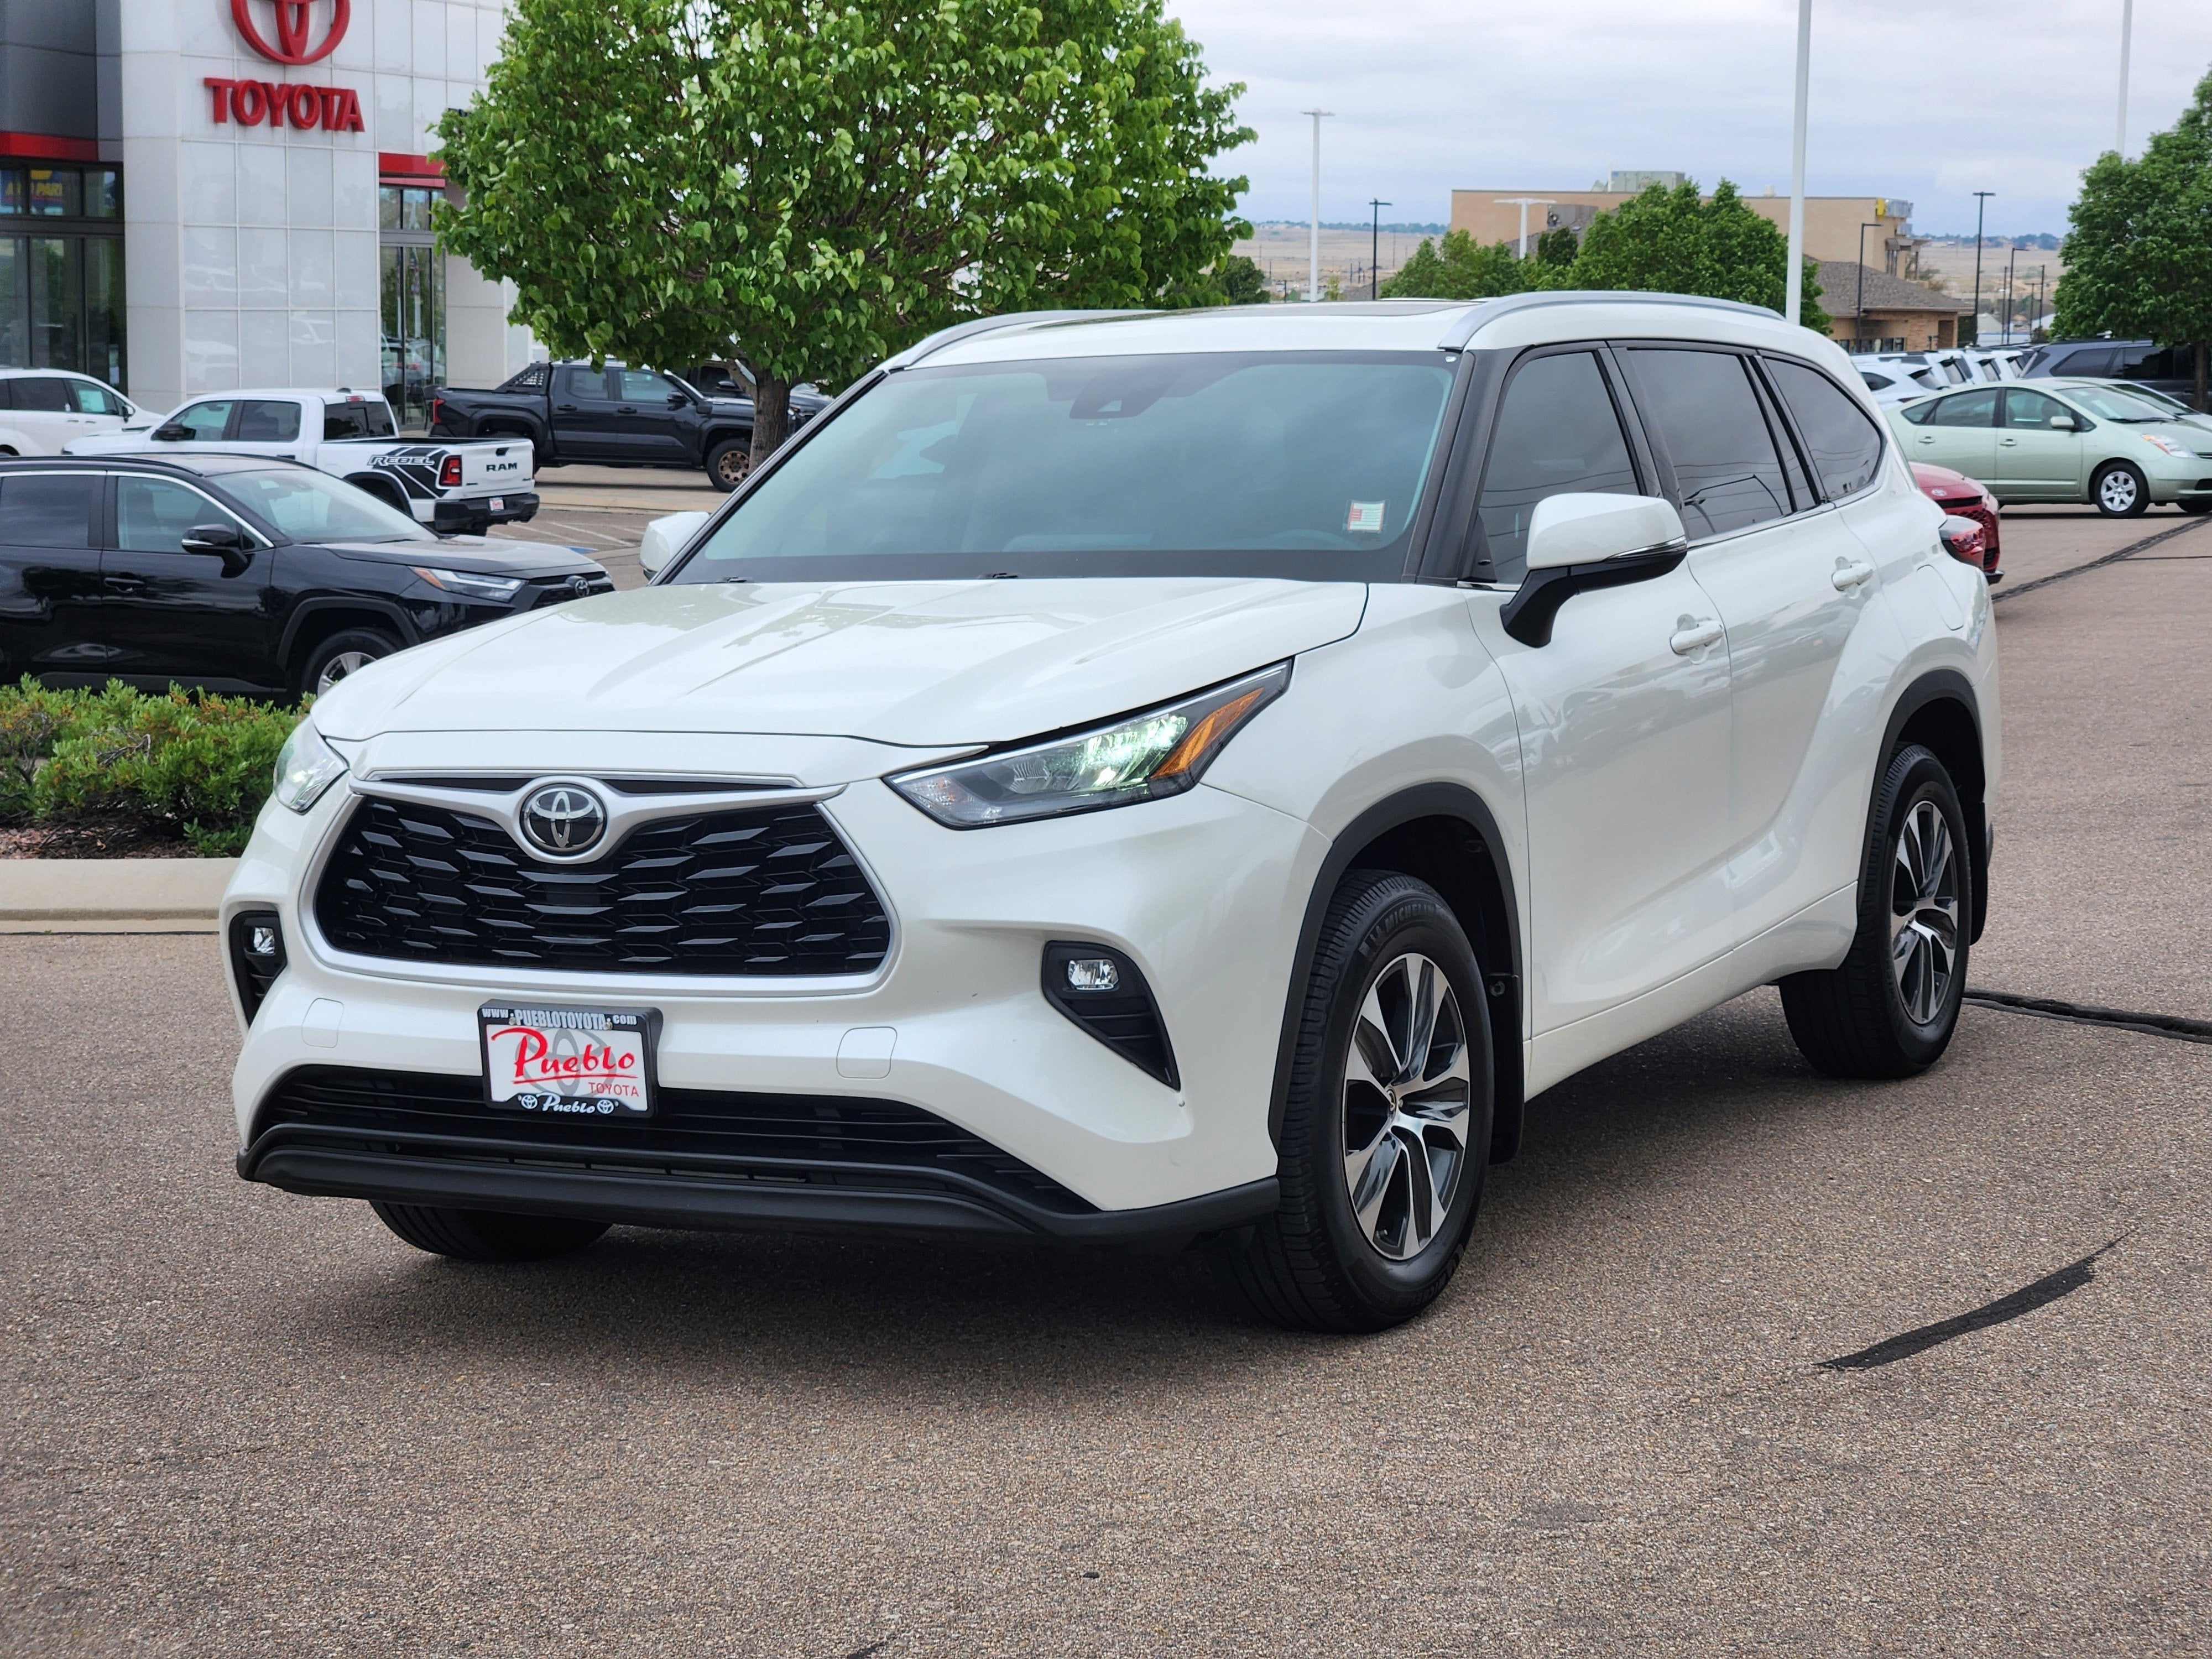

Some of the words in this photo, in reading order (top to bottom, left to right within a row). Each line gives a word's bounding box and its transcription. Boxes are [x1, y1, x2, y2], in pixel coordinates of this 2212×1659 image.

[204, 77, 365, 132] TOYOTA
[367, 455, 435, 466] REBEL
[486, 462, 518, 472] RAM
[491, 1027, 635, 1077] Pueblo
[588, 1082, 639, 1097] TOYOTA
[536, 1092, 596, 1114] Pueblo
